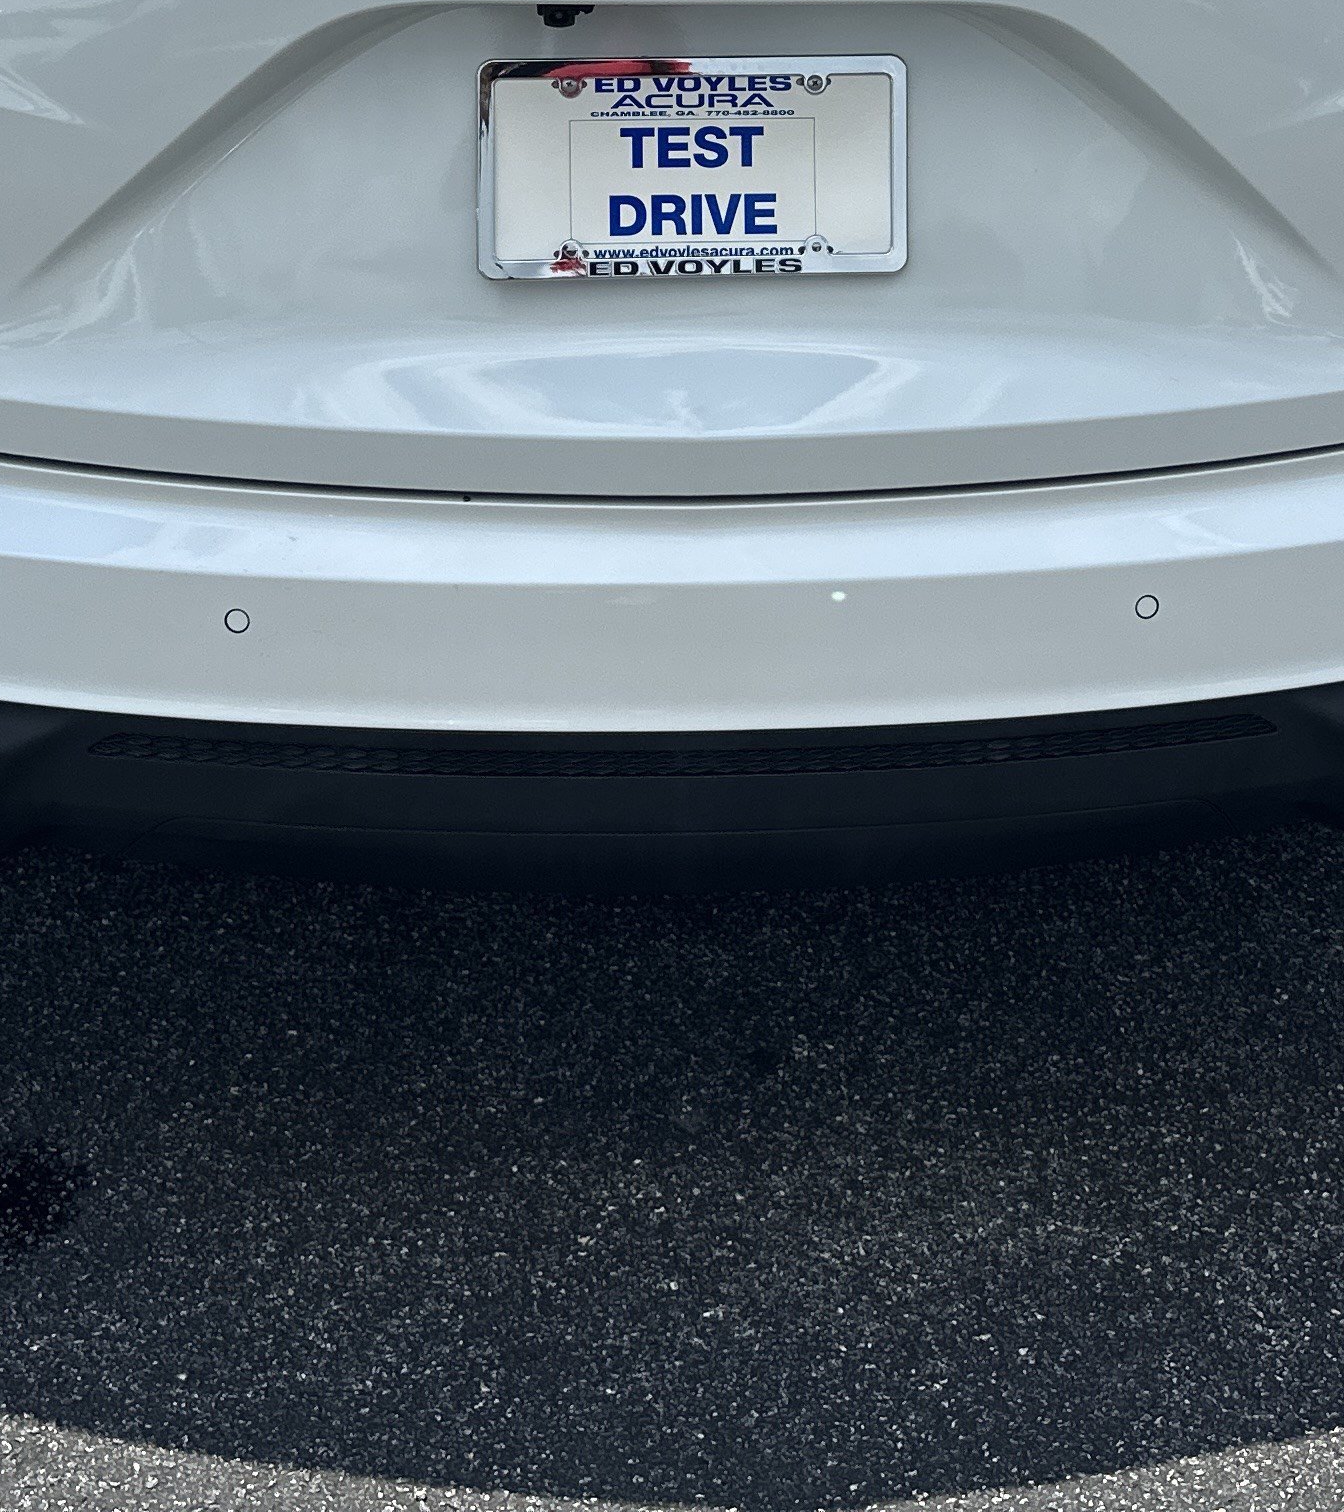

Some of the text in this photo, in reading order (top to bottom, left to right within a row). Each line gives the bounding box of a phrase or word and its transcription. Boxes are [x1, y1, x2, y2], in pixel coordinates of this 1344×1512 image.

[594, 76, 792, 93] ED VOYLES
[610, 93, 775, 109] ACURA
[619, 125, 765, 169] TEST
[609, 193, 778, 237] DRIVE
[593, 245, 794, 259] www.edvoylesacura.com
[589, 258, 802, 276] ED VOYLES
